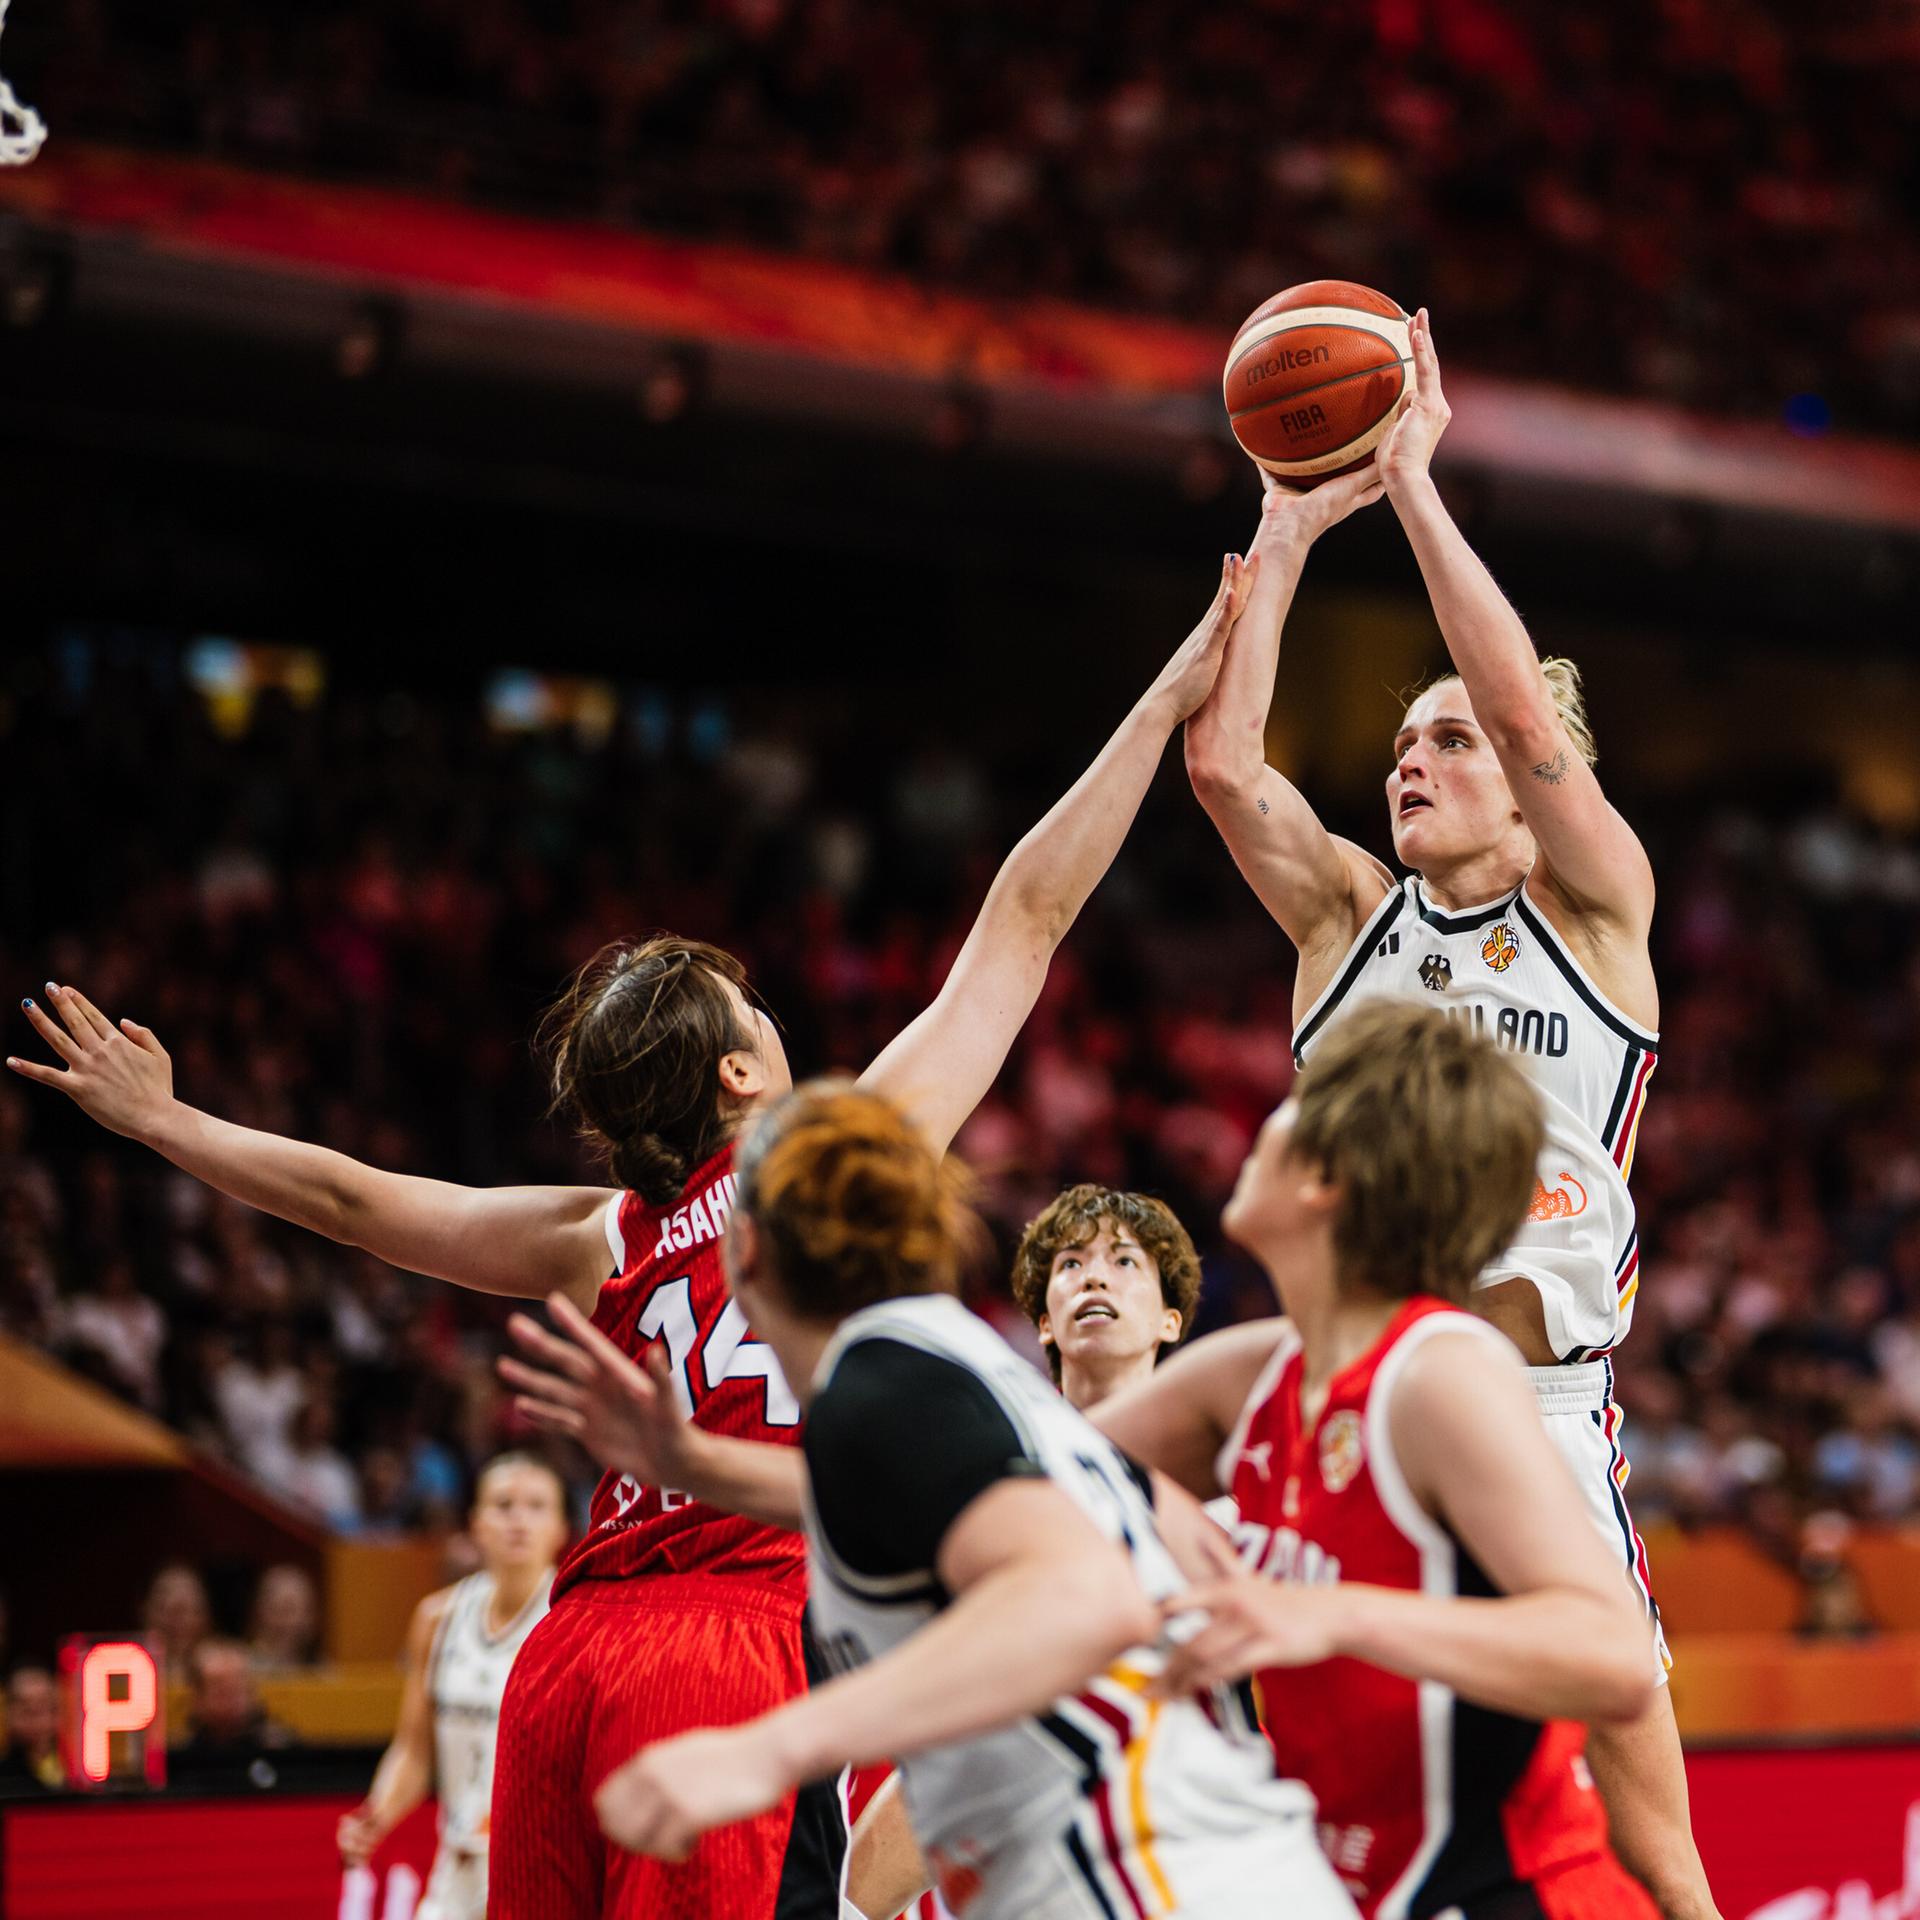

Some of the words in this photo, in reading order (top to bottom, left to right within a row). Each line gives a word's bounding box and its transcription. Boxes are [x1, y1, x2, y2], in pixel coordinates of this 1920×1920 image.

[1246, 345, 1330, 386] molten
[1280, 404, 1326, 434] FIBA
[637, 1276, 800, 1426] 14
[82, 1641, 157, 1781] P
